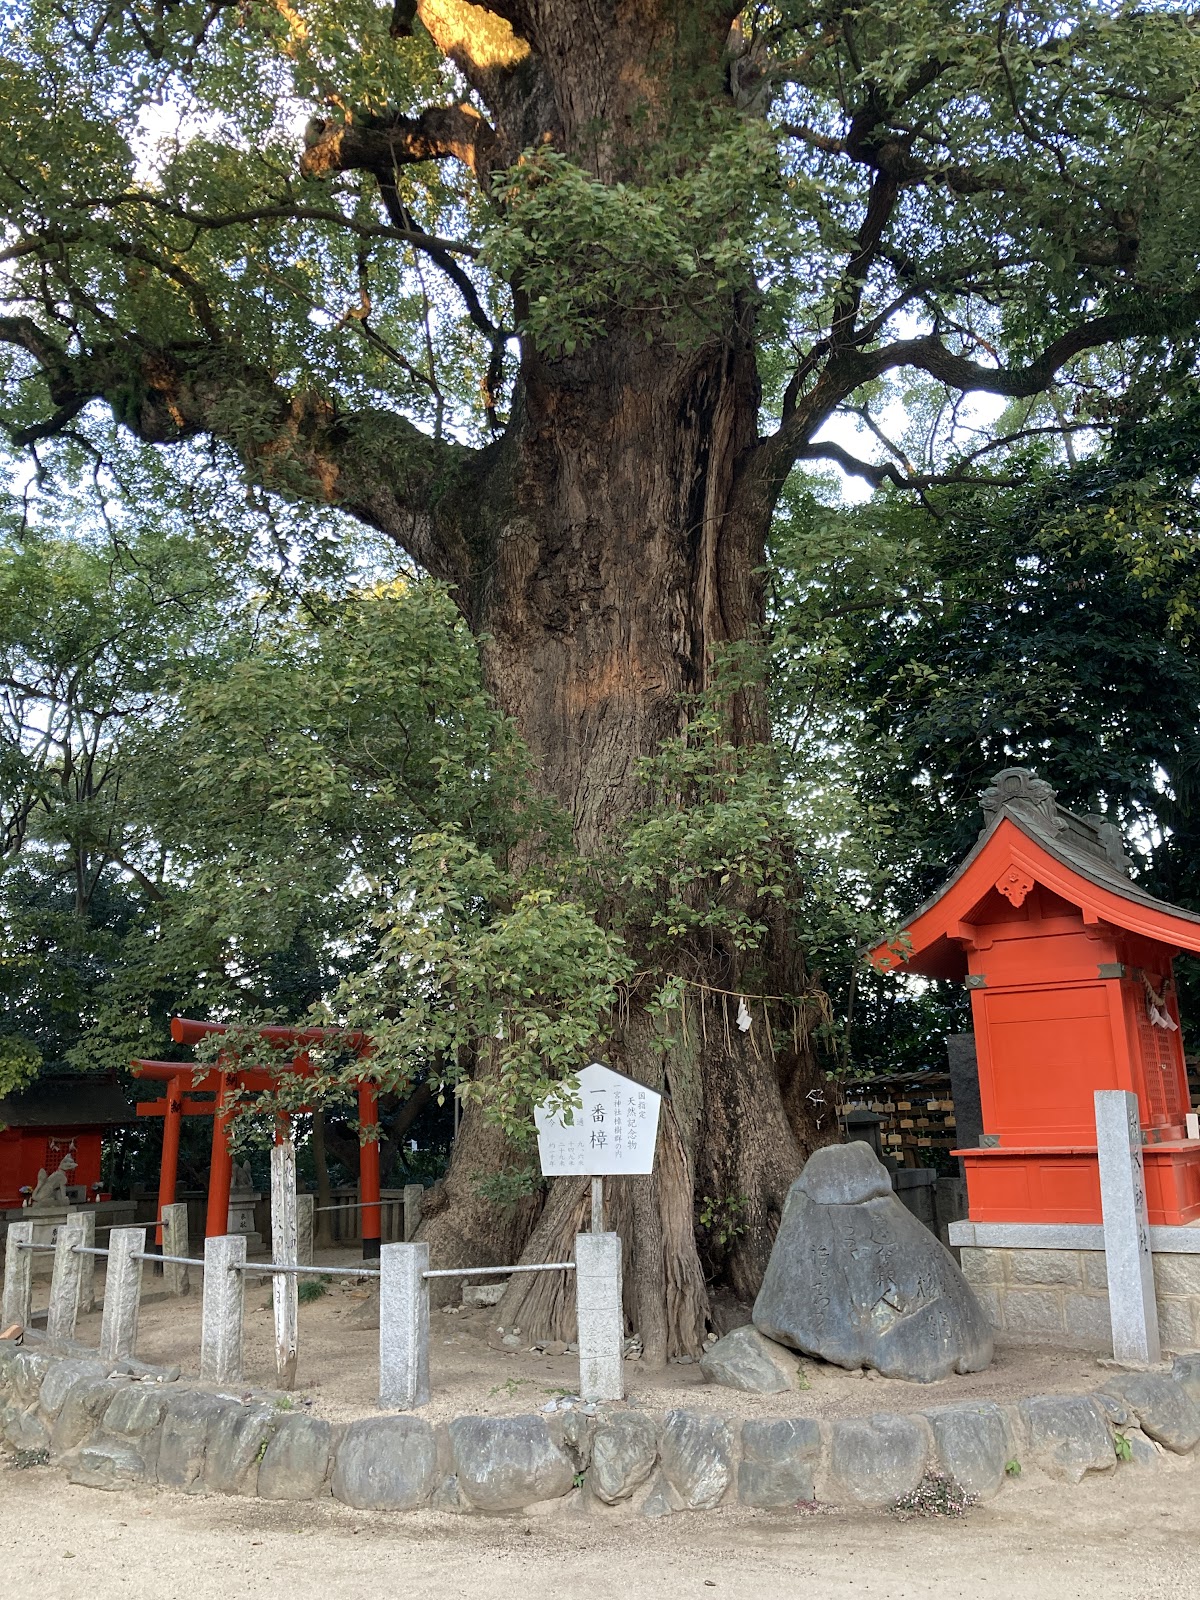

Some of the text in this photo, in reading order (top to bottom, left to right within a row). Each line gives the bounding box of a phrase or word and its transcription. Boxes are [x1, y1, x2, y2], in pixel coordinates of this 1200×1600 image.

[589, 1089, 609, 1150] 一番樟
[613, 1084, 623, 1159] 一宮神社樟樹群の内
[627, 1097, 638, 1150] 天然記念物
[638, 1092, 646, 1119] 国指定
